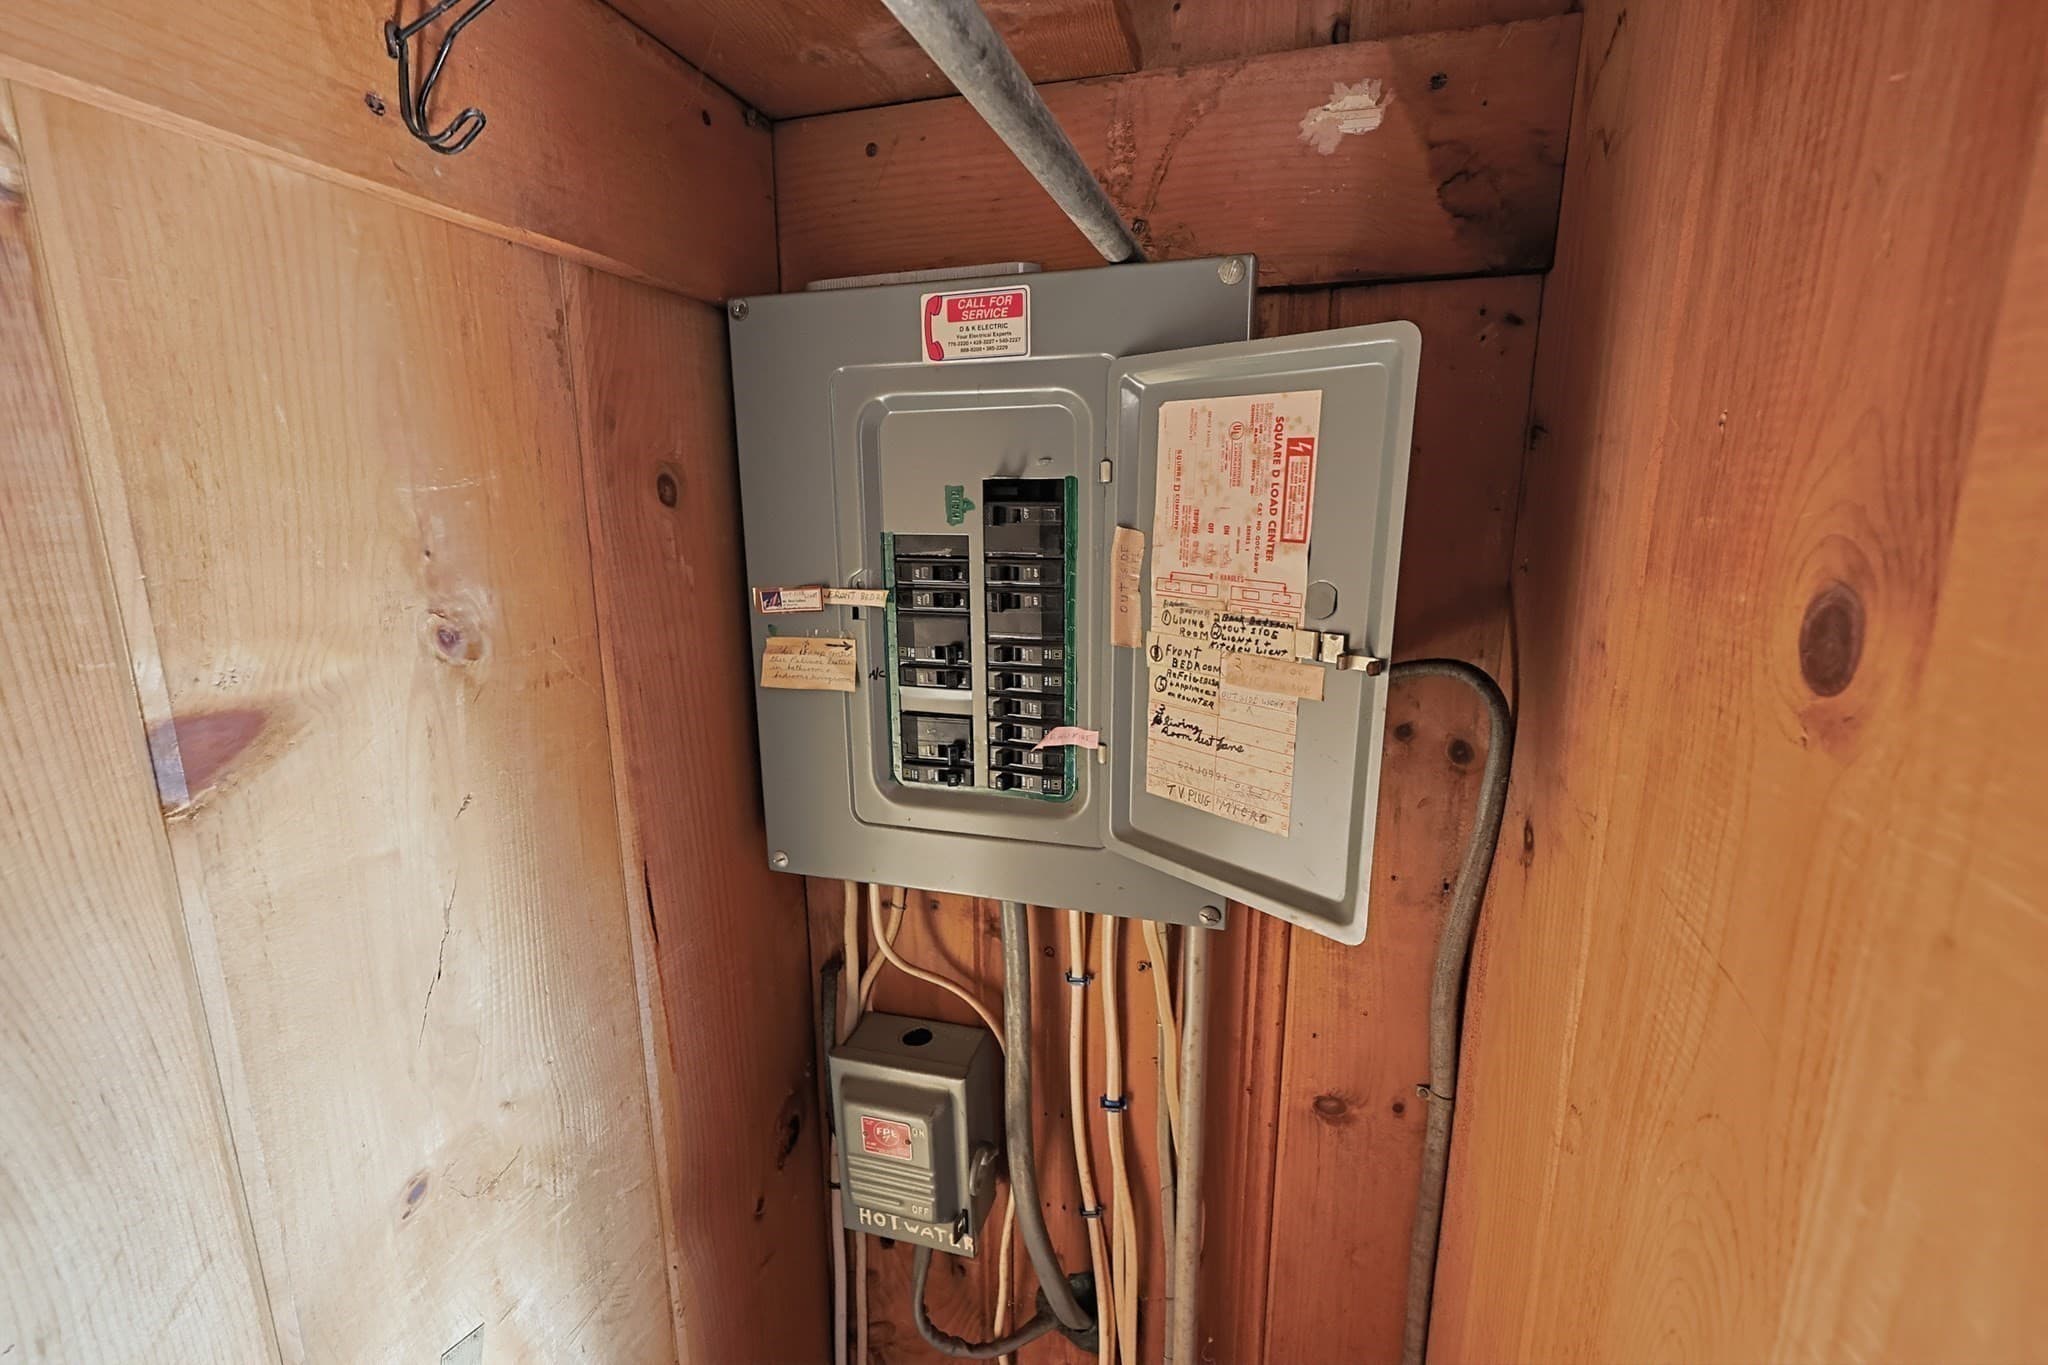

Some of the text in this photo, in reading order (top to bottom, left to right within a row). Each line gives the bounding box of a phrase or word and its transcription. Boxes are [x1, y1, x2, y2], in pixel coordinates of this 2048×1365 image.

[957, 295, 1013, 310] CALL FOR
[961, 307, 1009, 321] SERVICE
[977, 323, 1008, 331] ELECTRIC
[1265, 416, 1284, 562] SQUARE D LOAD CENTER
[1191, 509, 1199, 534] TRIPPED
[1179, 627, 1209, 641] ROOM
[912, 1127, 925, 1137] ON
[912, 1205, 929, 1216] OFF
[859, 1207, 901, 1231] HOT
